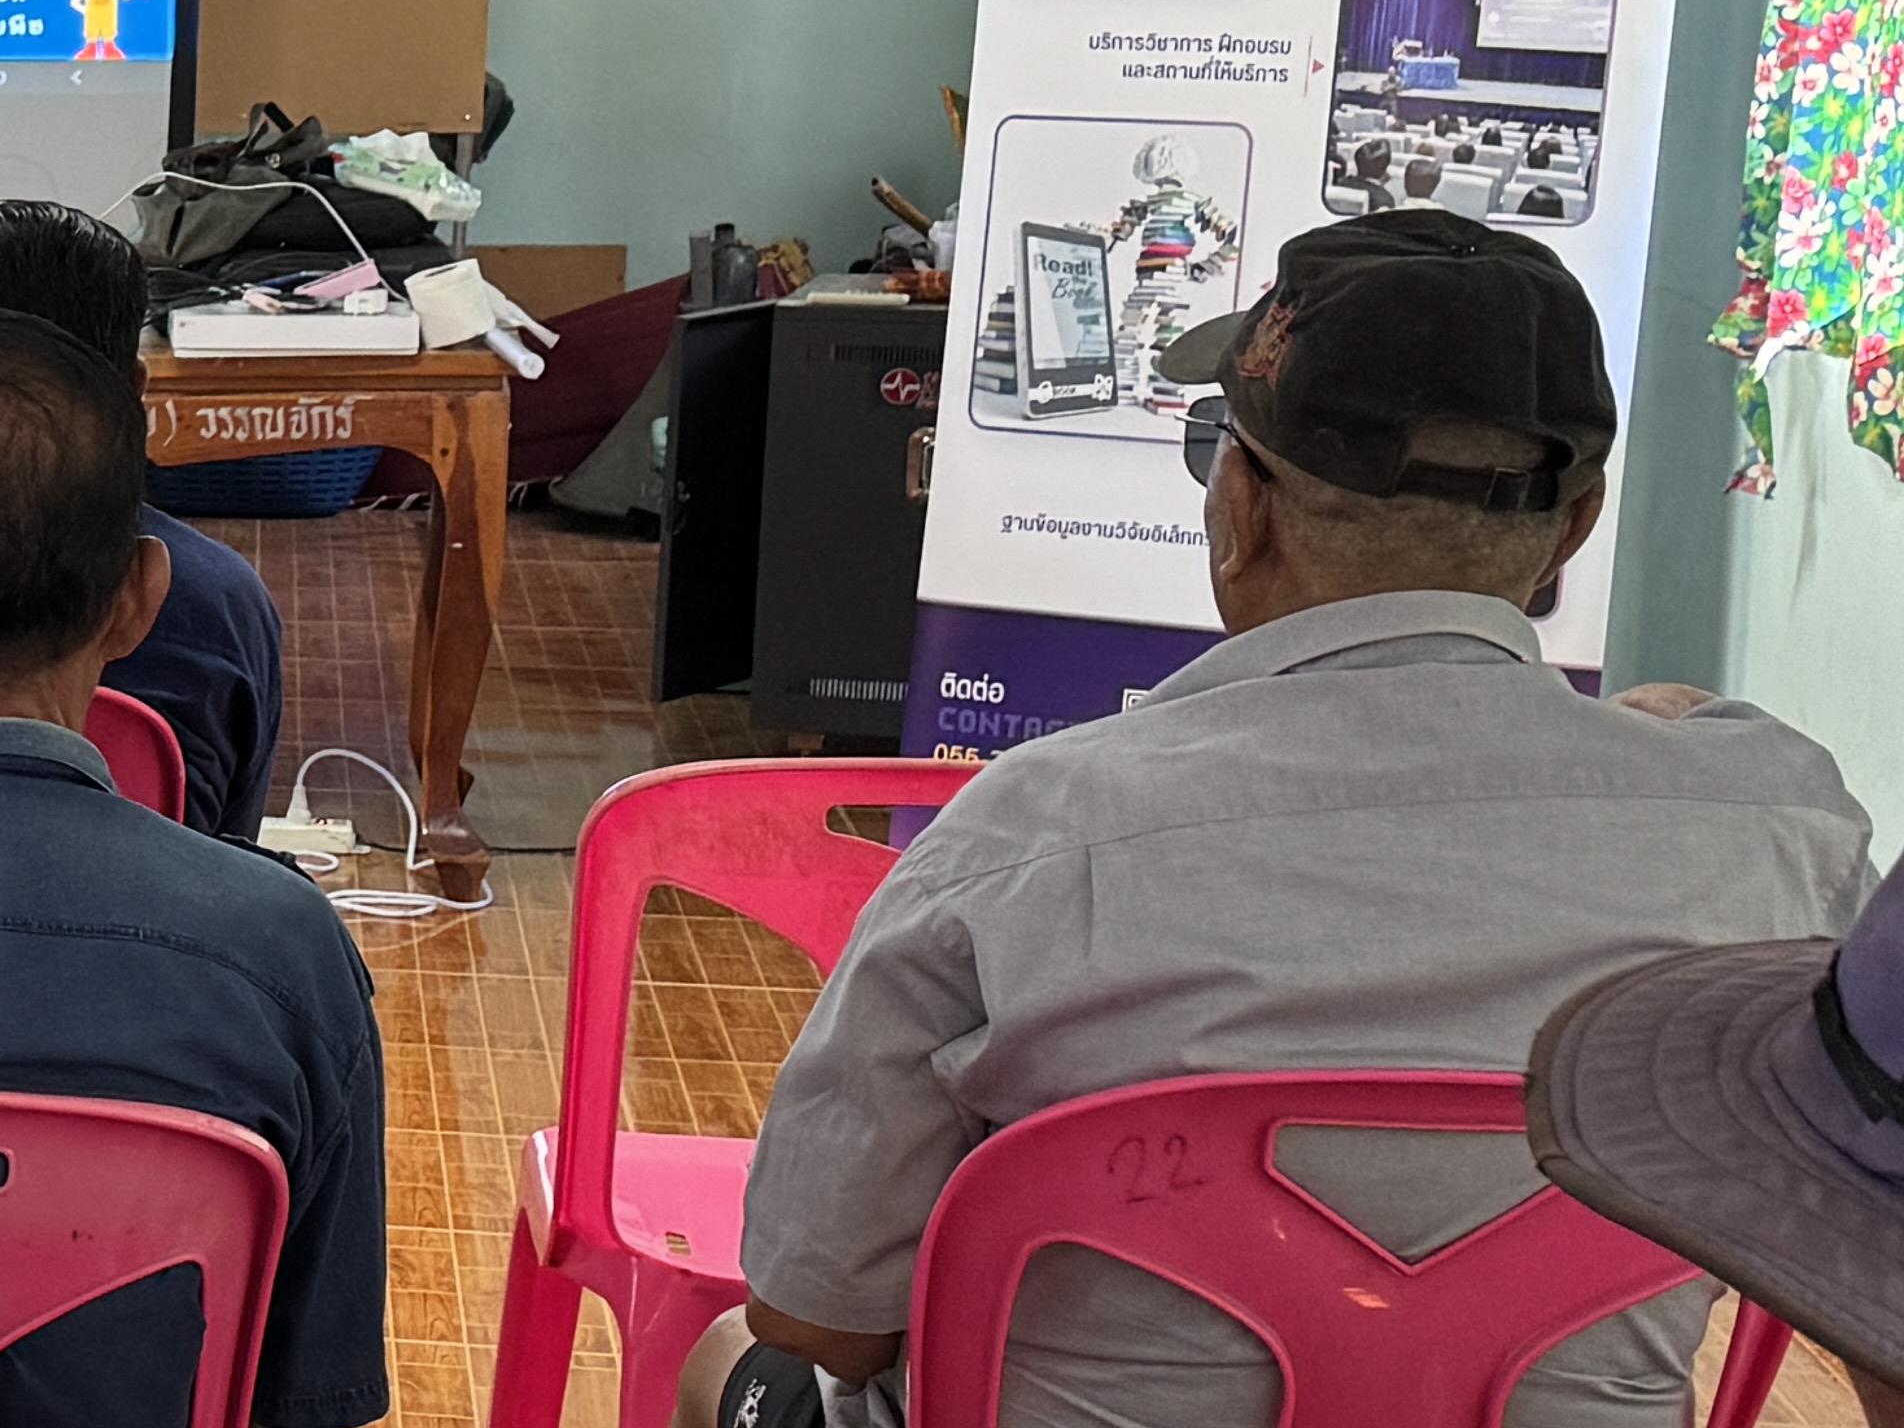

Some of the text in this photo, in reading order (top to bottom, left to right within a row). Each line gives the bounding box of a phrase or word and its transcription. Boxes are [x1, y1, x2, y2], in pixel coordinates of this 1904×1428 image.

[1089, 31, 1291, 55] บริการวิชาการ ฝึกอบรม
[1123, 56, 1288, 83] และสถานที่ให้บริการ
[1000, 513, 1210, 547] ฐานข้อมูลงานวิจัยอิเล็กท
[940, 672, 1005, 703] ติดต่อ
[1108, 1133, 1205, 1204] 22
